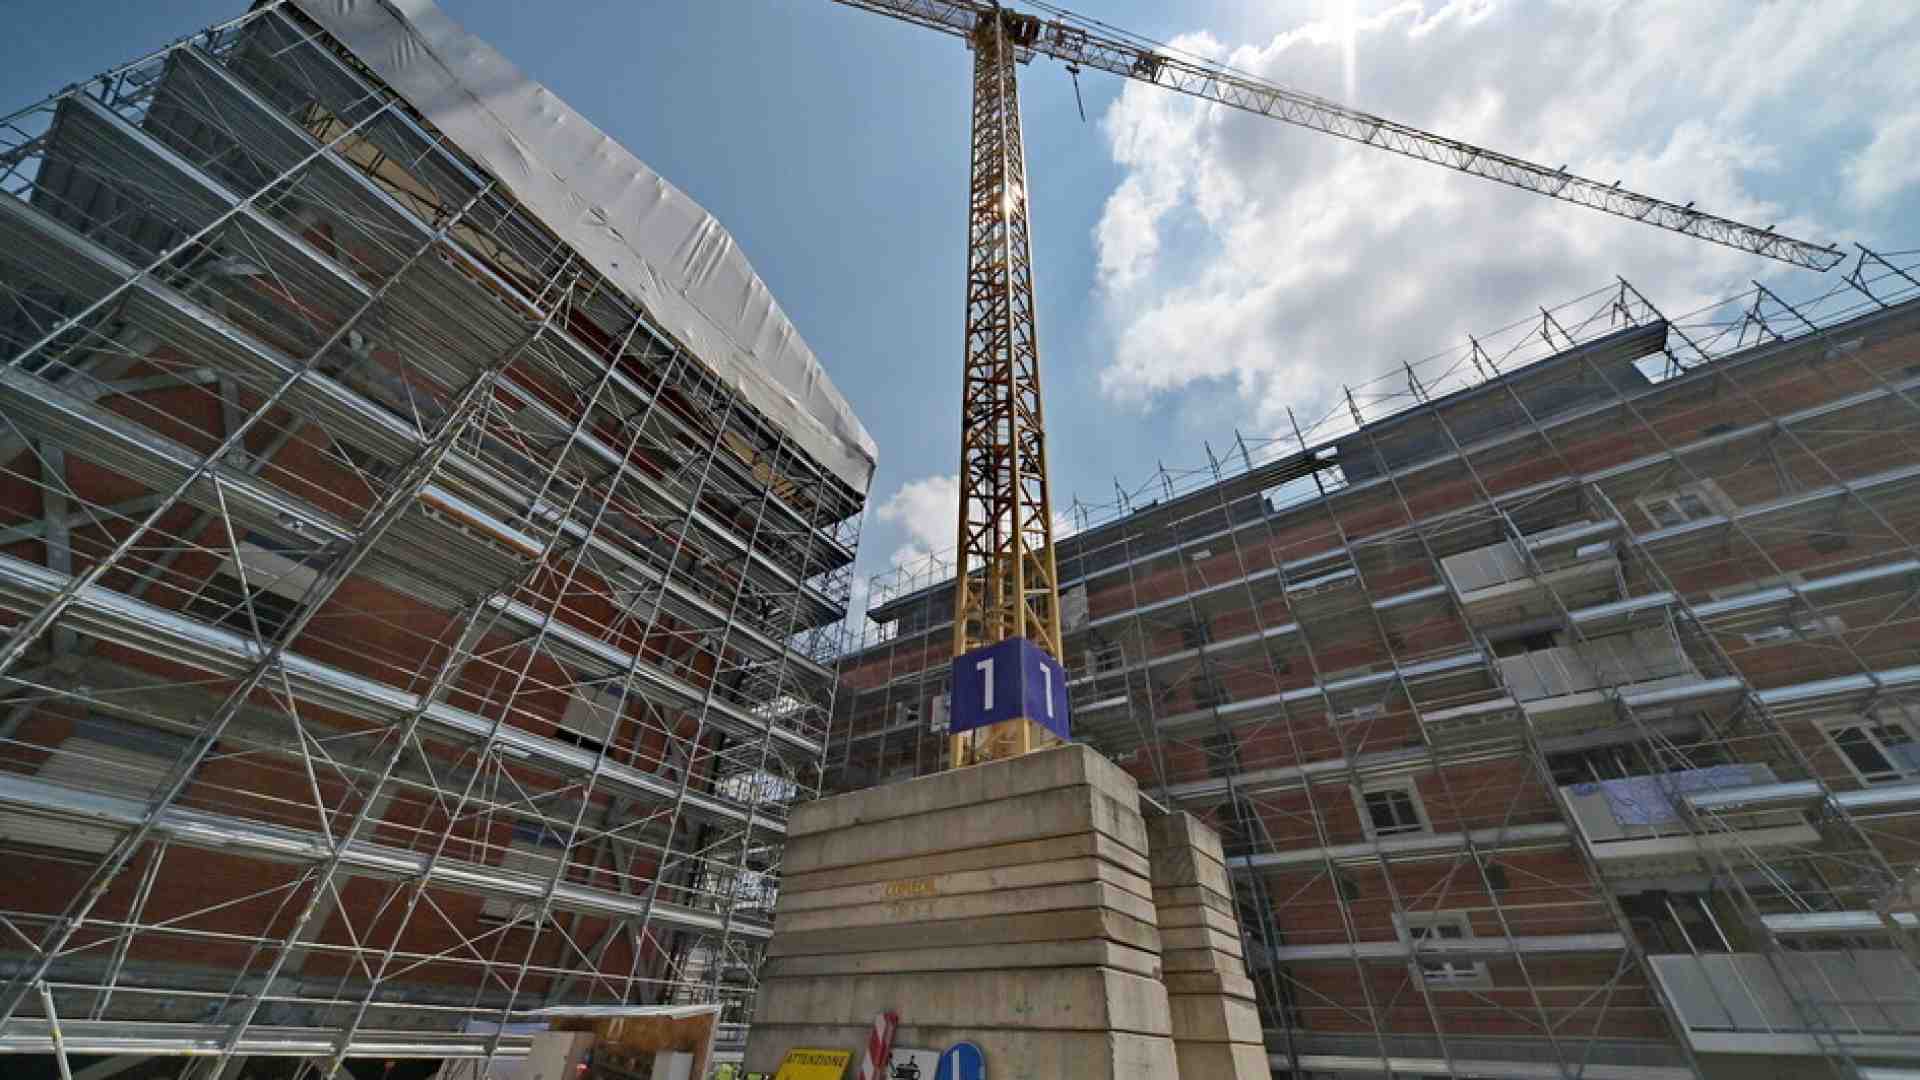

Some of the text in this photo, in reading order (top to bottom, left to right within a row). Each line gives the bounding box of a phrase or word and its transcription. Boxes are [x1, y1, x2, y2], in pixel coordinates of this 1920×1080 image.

[976, 658, 994, 710] 1
[1040, 661, 1054, 719] 1
[785, 1053, 846, 1067] ATTENZIONE
